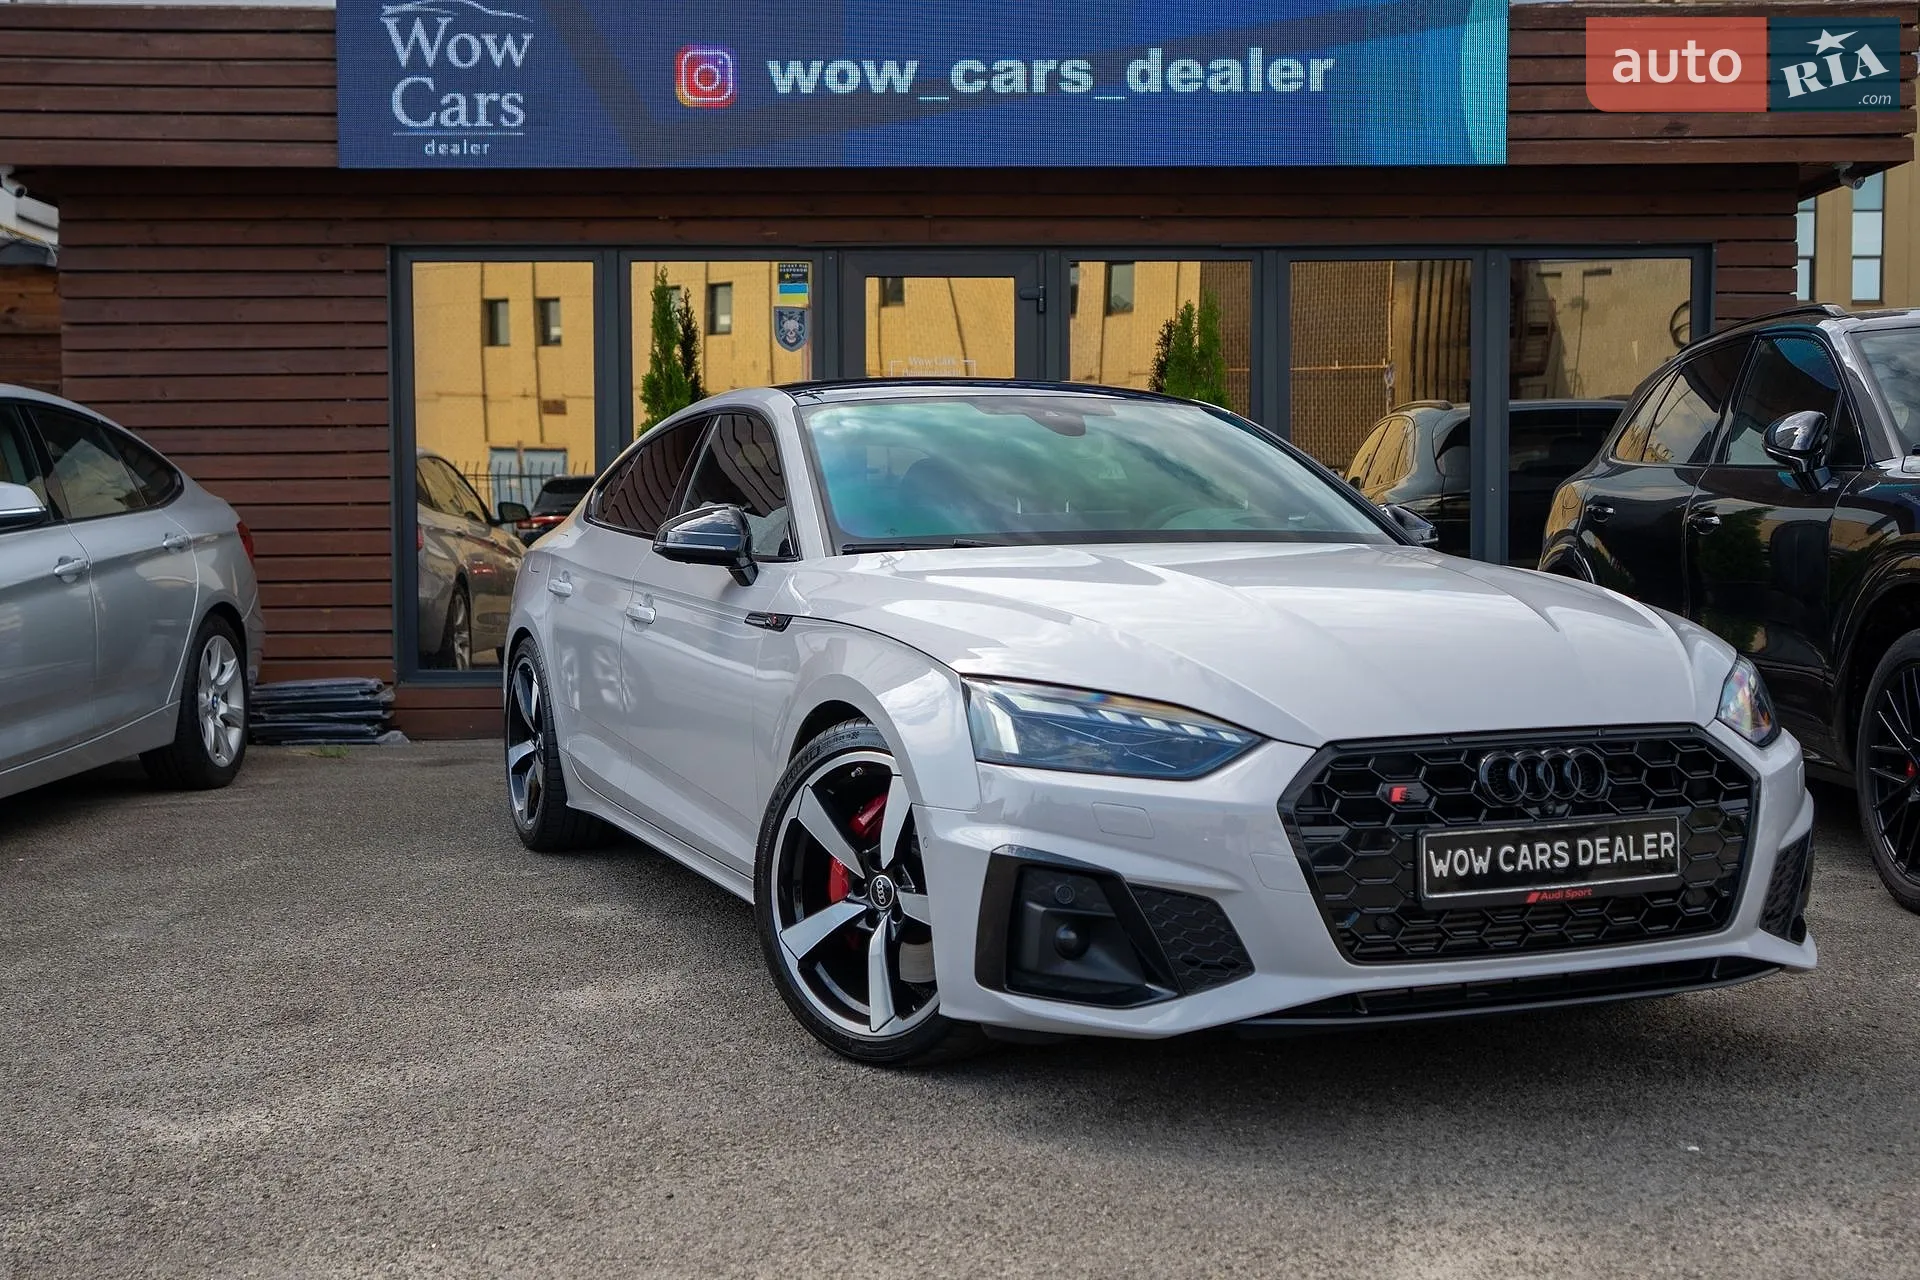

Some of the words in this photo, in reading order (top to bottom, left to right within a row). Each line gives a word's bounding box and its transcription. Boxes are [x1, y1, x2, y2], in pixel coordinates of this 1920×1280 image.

[380, 17, 534, 69] Wow
[766, 47, 1335, 100] wow_cars_dealer
[392, 76, 525, 129] Cars
[424, 139, 490, 156] dealer
[1429, 846, 1491, 878] WOW
[1499, 840, 1570, 873] CARS
[1577, 831, 1675, 866] DEALER
[1541, 889, 1564, 900] Audi
[1565, 887, 1593, 899] Sport
